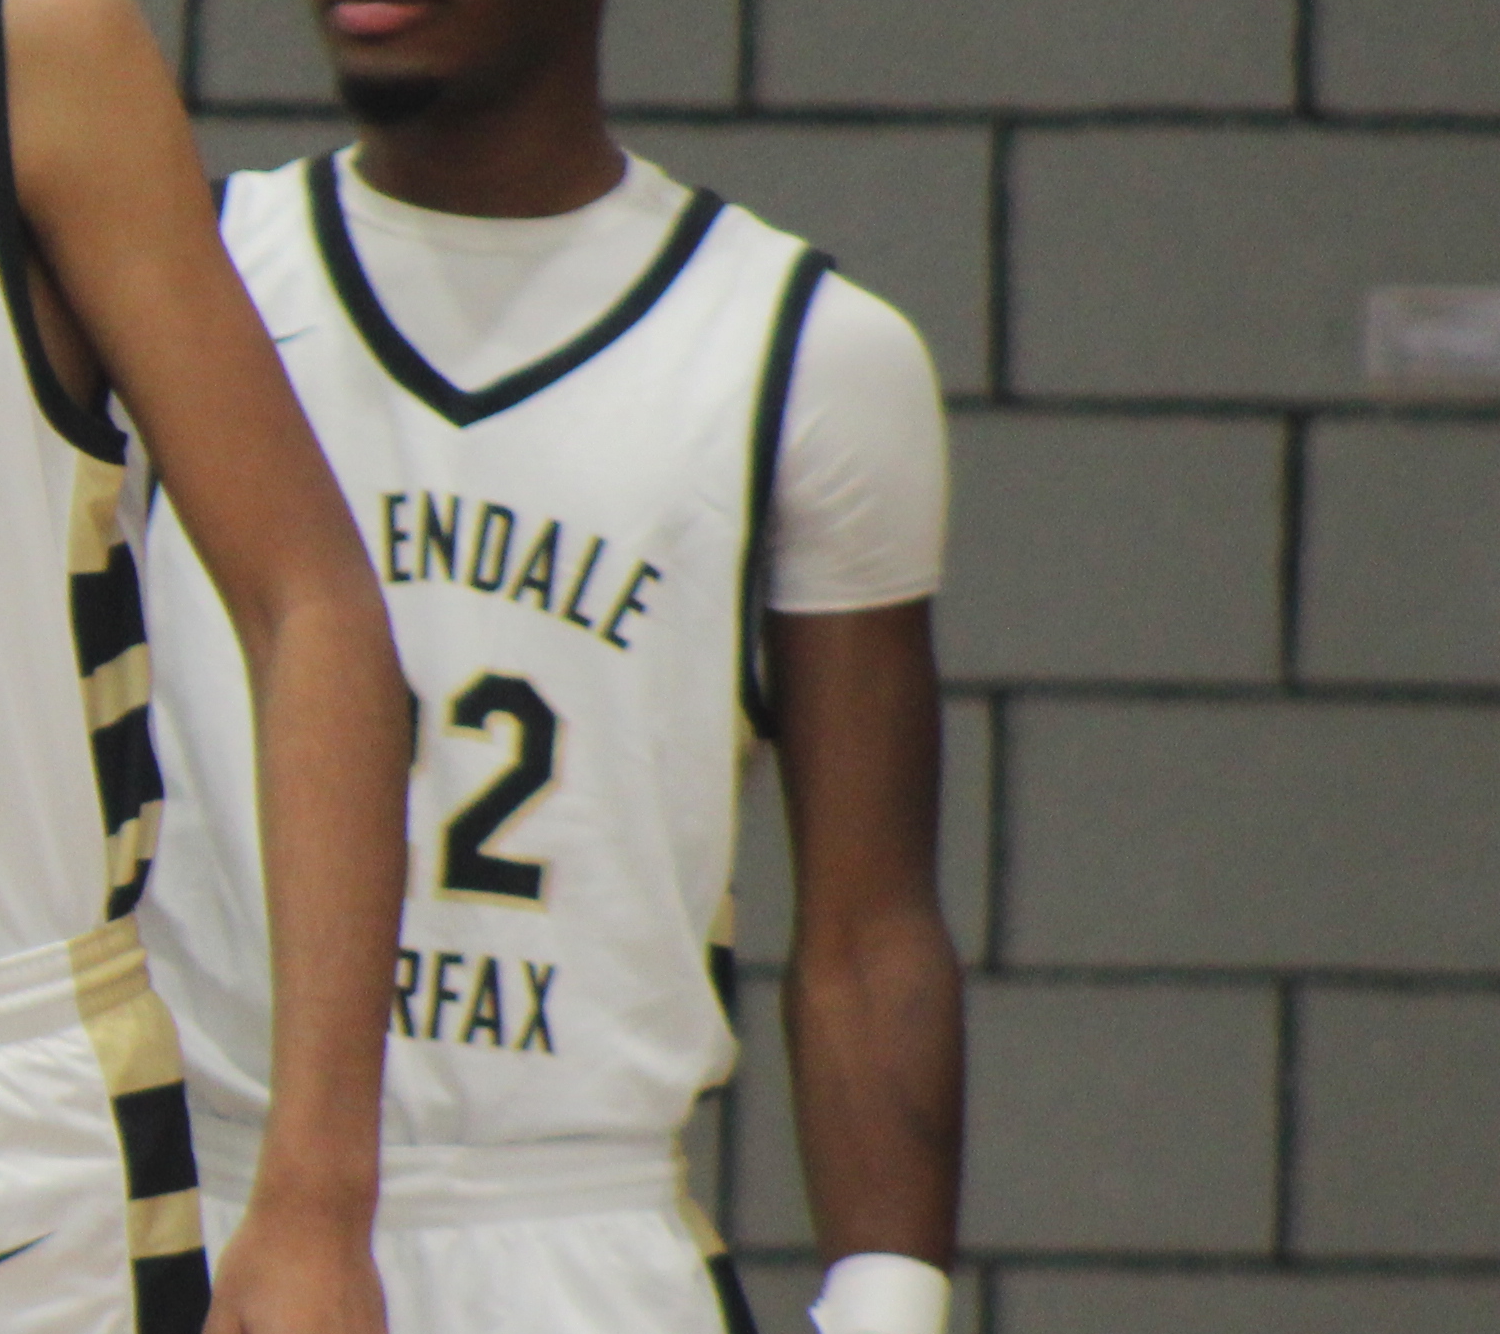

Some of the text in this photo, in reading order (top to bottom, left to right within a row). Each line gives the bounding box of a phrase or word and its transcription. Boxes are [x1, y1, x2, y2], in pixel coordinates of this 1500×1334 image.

[378, 489, 663, 653] ENDALE
[403, 671, 566, 913] 2
[388, 947, 556, 1057] RFAX
